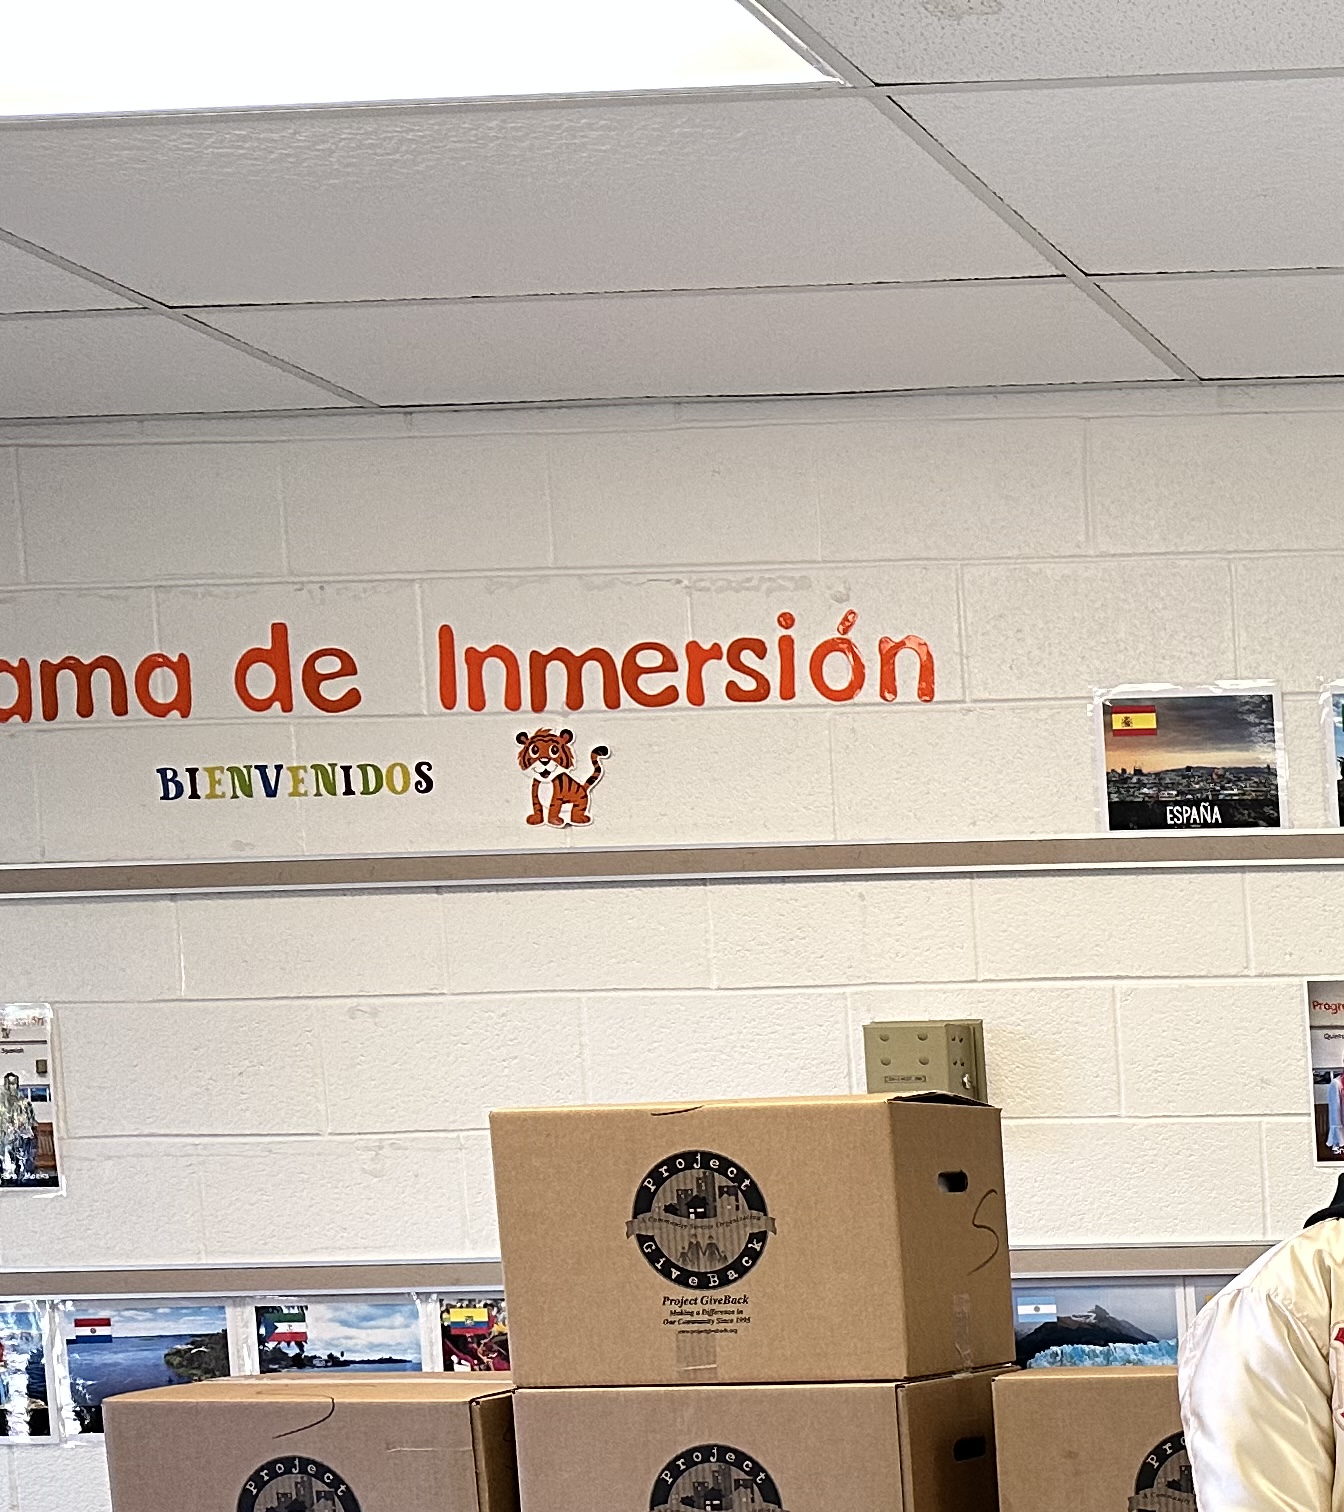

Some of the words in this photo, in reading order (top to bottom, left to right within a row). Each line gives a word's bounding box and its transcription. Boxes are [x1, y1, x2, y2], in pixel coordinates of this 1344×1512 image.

[234, 622, 361, 713] de
[438, 609, 935, 712] Inmersión
[156, 761, 434, 800] BIENVENIDOS
[1166, 802, 1222, 825] ESPAÑA
[643, 1152, 752, 1192] Project
[643, 1239, 763, 1287] GiveBack
[661, 1295, 699, 1308] Project
[699, 1294, 749, 1306] GiveBack
[245, 1457, 348, 1496] Project
[660, 1446, 767, 1485] Project
